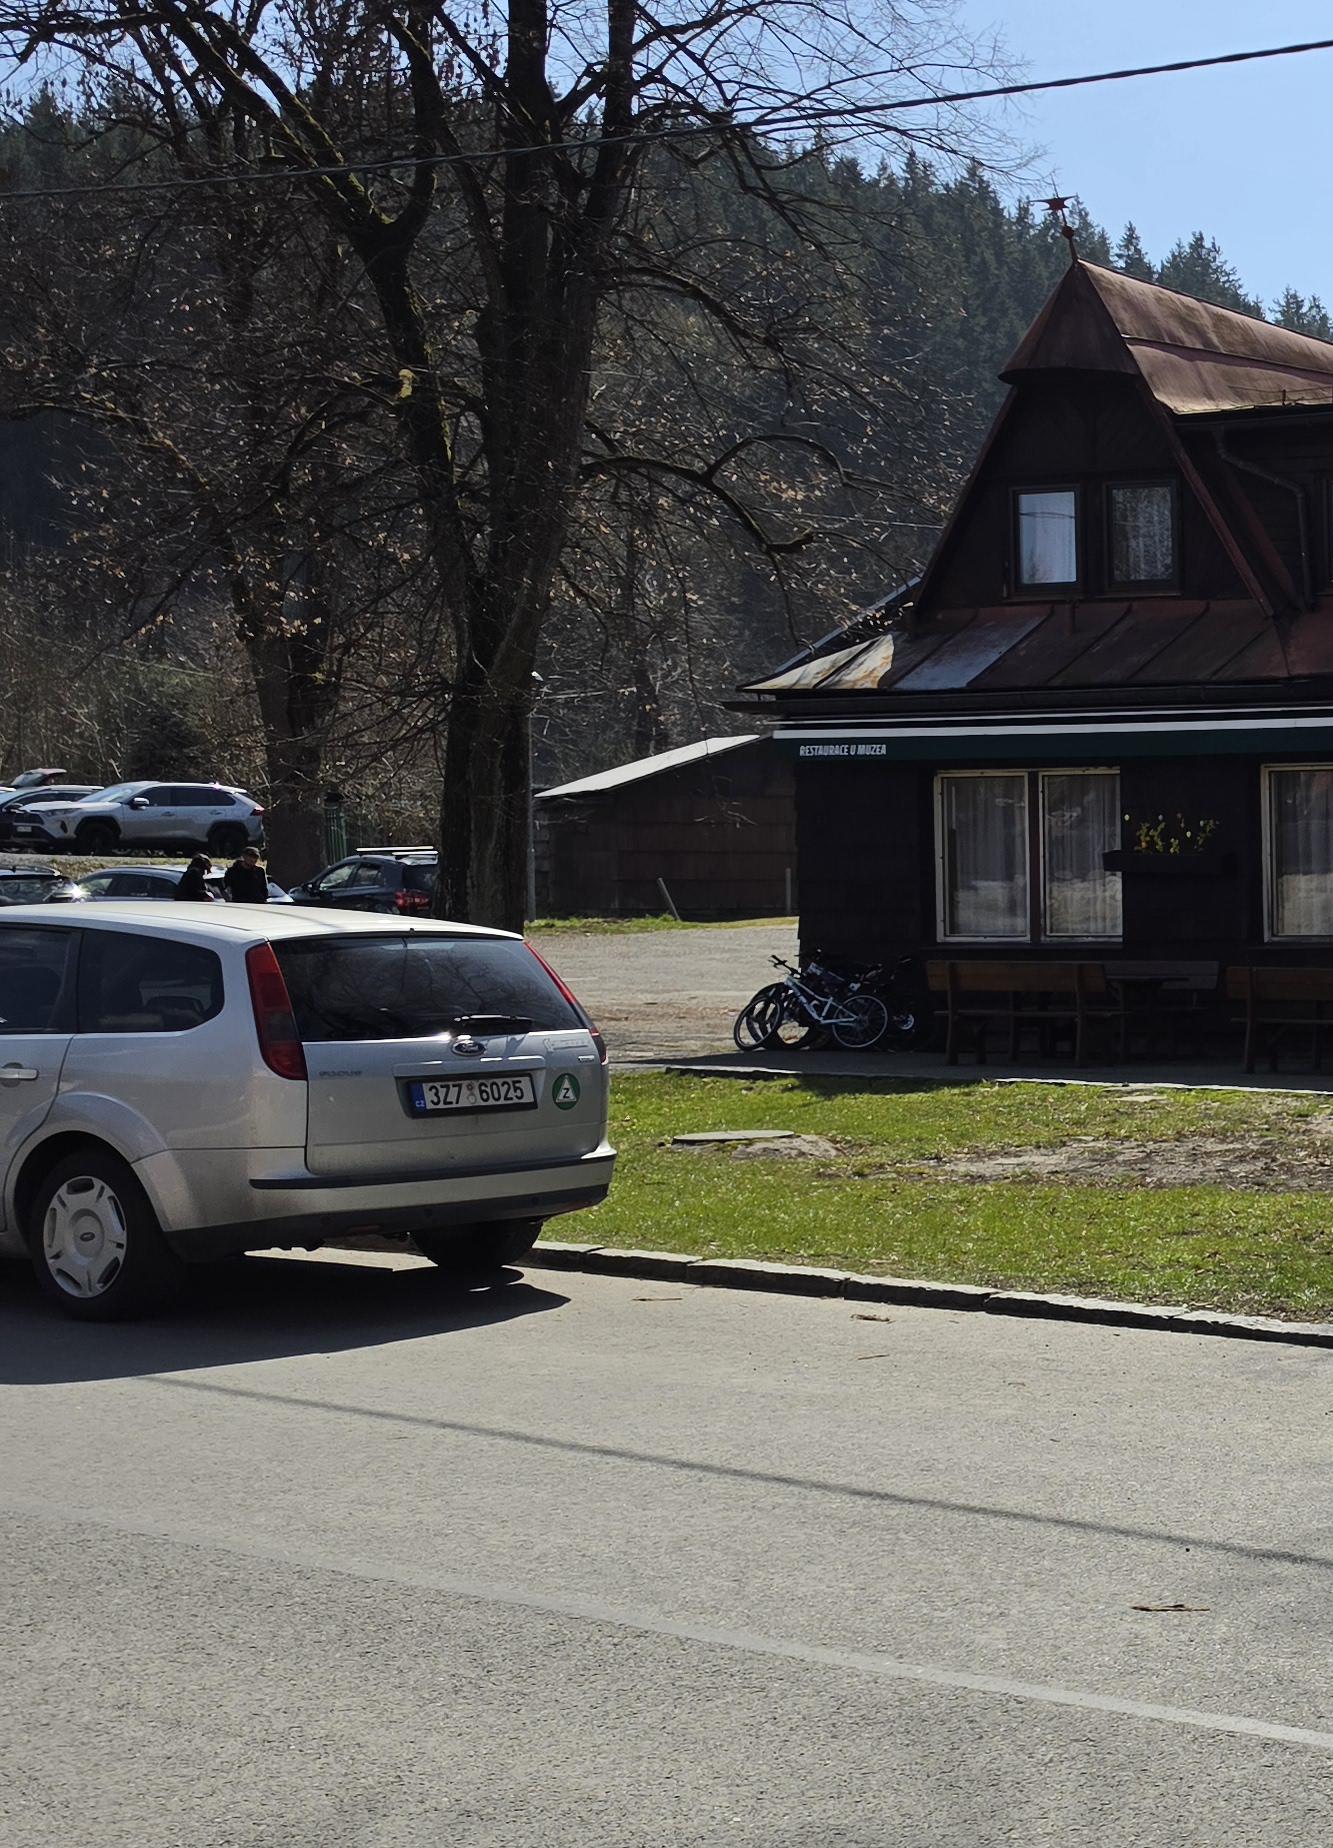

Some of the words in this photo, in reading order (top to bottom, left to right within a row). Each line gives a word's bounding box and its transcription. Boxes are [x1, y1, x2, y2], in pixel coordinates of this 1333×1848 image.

[800, 745, 849, 757] RESTAURACE
[850, 745, 857, 756] U
[857, 744, 887, 755] MUZEA
[428, 1083, 463, 1106] 3Z7
[478, 1080, 524, 1103] 6025
[562, 1087, 571, 1099] Z
